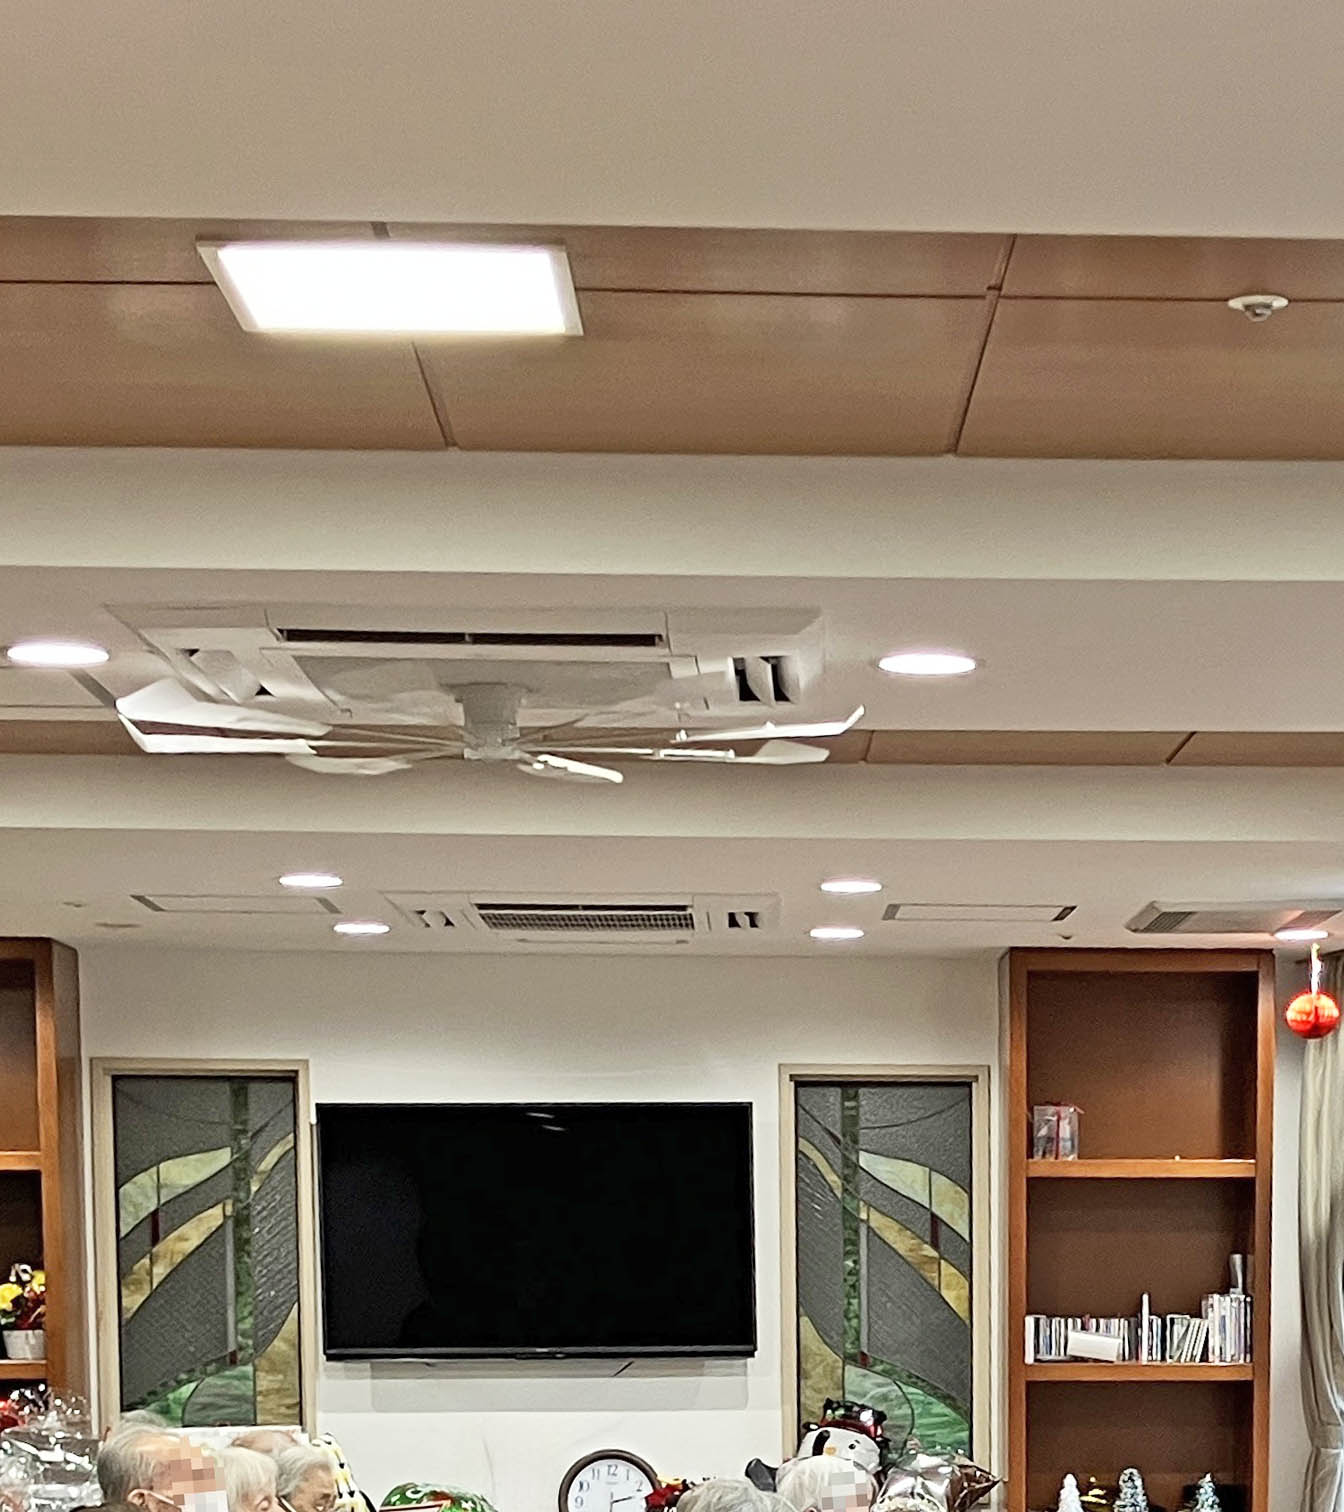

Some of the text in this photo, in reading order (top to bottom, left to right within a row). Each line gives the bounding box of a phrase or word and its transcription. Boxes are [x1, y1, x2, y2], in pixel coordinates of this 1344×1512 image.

[591, 1468, 600, 1480] 11
[607, 1464, 618, 1477] 12
[578, 1480, 590, 1493] 10
[636, 1480, 643, 1492] 2
[575, 1496, 584, 1508] 9
